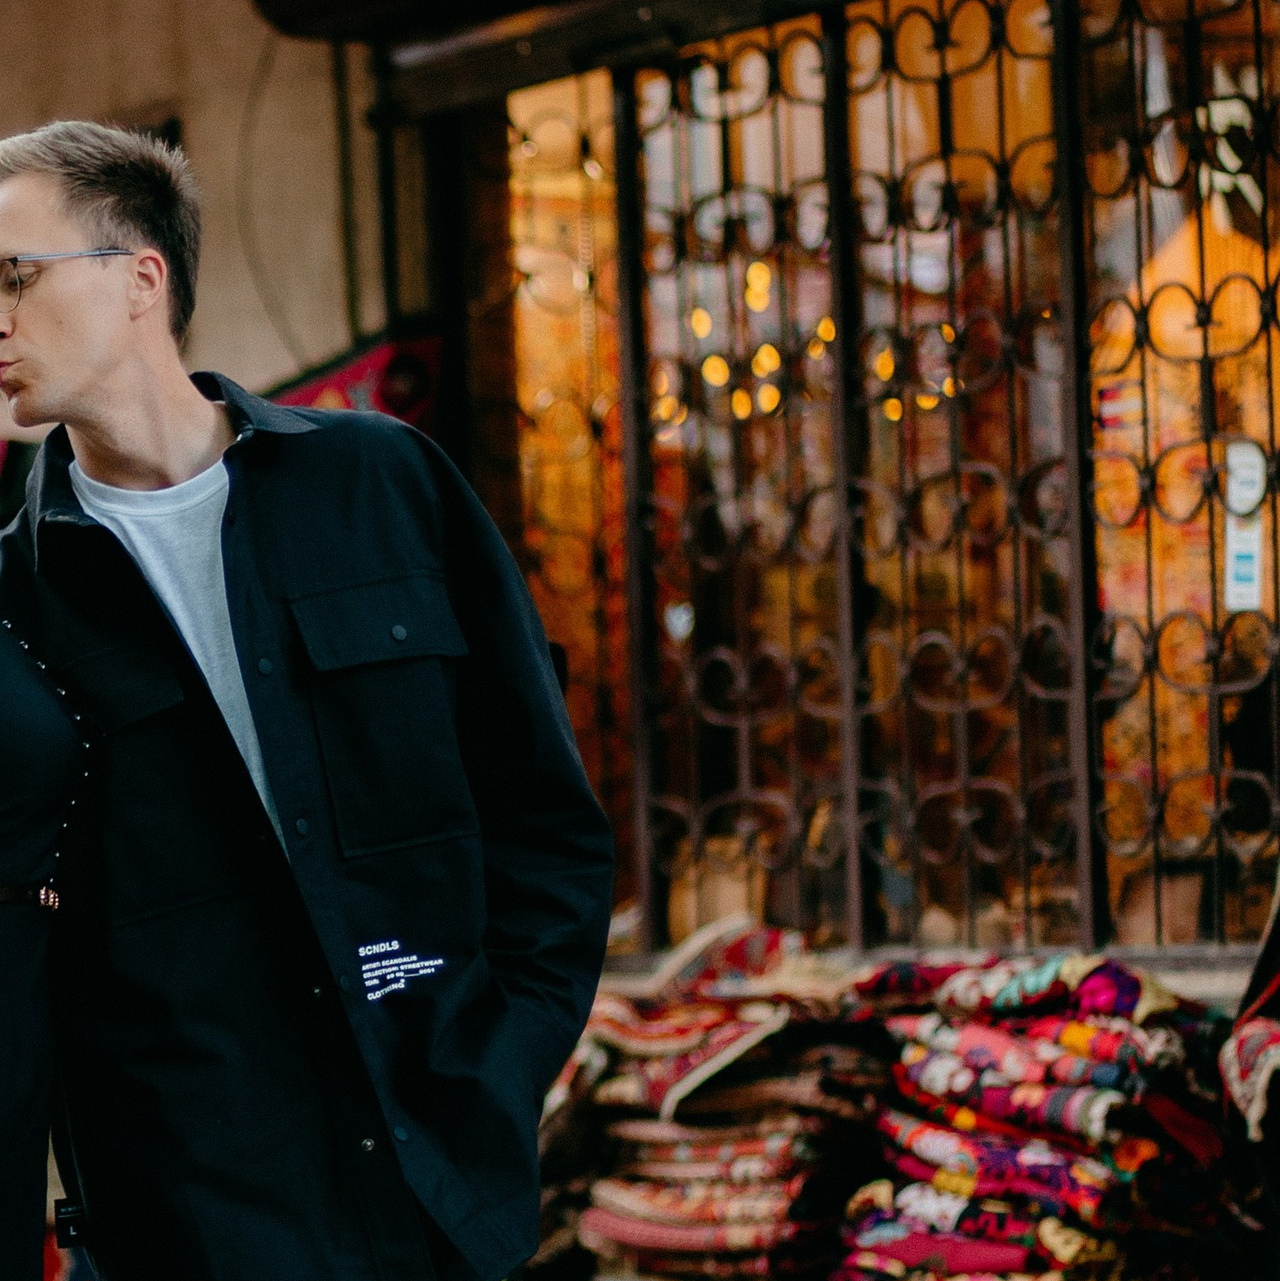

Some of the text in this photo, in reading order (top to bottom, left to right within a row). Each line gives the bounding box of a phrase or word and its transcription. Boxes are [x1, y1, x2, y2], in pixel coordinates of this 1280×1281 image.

[358, 940, 399, 956] SCNDLS
[400, 959, 443, 970] STREETWEAR
[69, 1226, 77, 1235] L
